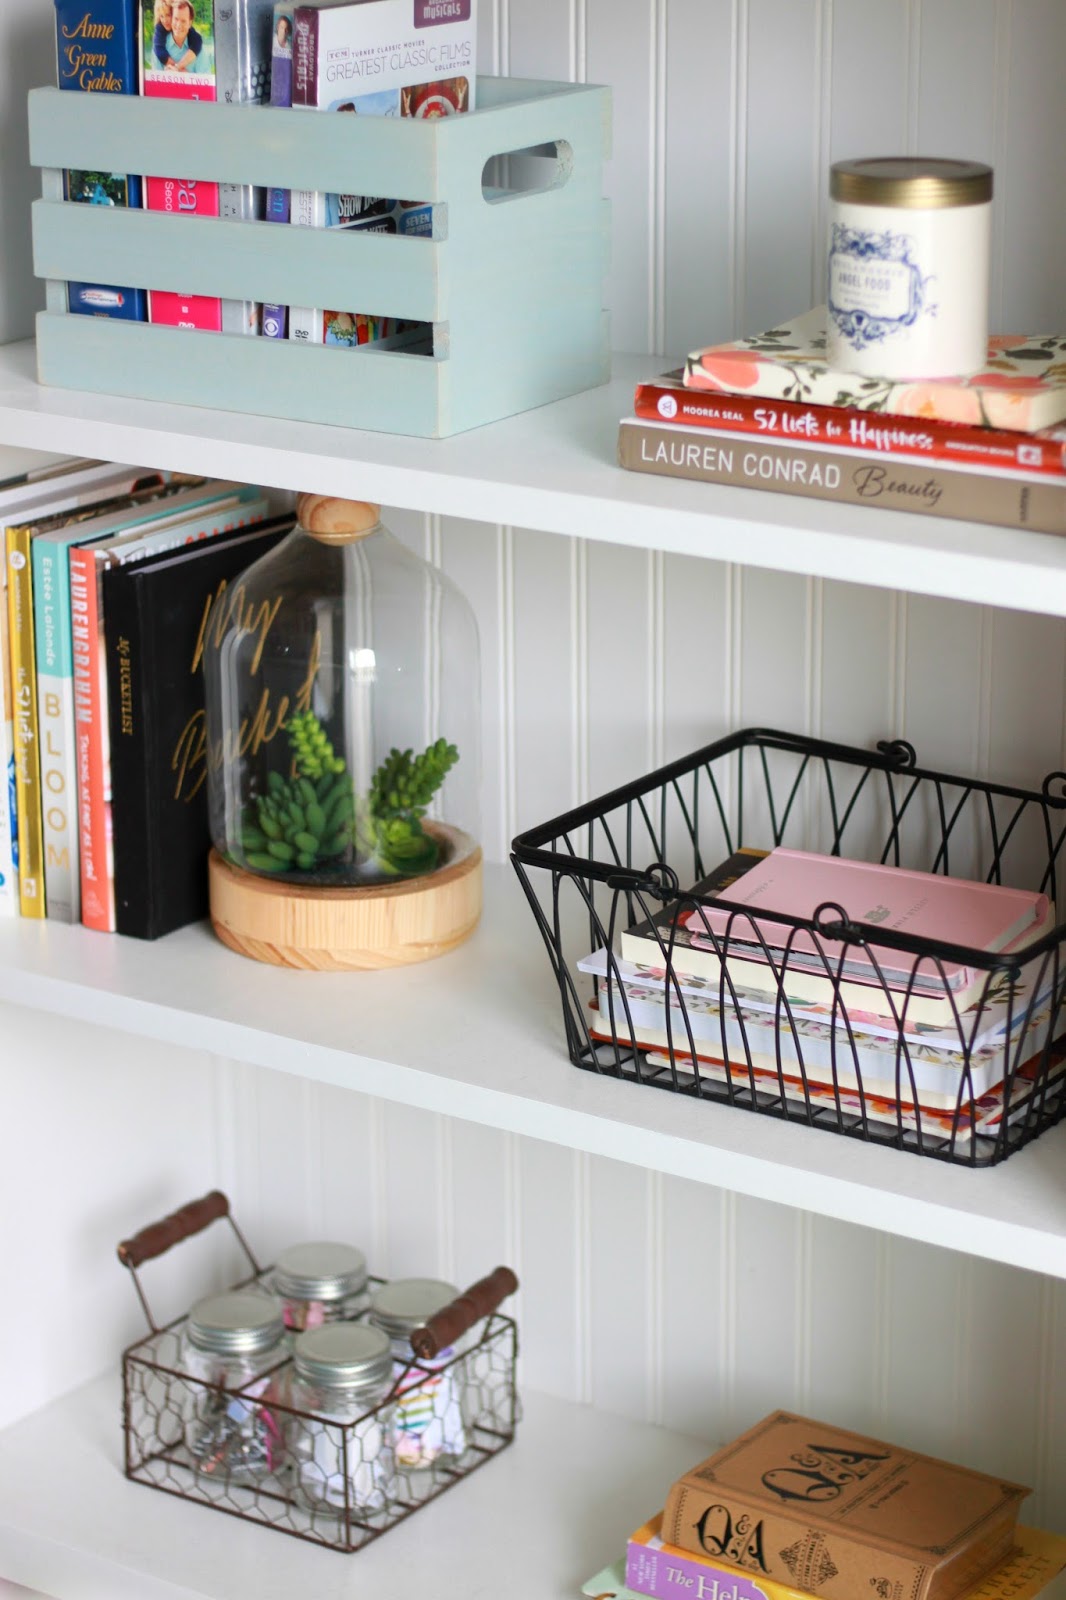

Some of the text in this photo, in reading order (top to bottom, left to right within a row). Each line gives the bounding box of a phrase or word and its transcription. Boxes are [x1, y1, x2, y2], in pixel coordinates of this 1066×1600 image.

[62, 13, 115, 40] Anne
[423, 3, 462, 19] MUSICALS
[62, 44, 107, 78] Green
[296, 21, 310, 91] MUSICALS
[308, 33, 316, 83] BROADWAY
[326, 41, 472, 82] GREATEST CLASSIC FILMS
[329, 39, 426, 59] TCM TURNER CLASSIC MOVIES
[434, 60, 471, 72] COLLECTION
[79, 69, 123, 92] Gables
[150, 74, 210, 86] SEASON TWO
[164, 181, 175, 211] Seco
[338, 194, 361, 217] SHOW
[864, 276, 892, 291] FOOD
[682, 405, 720, 419] MOOREA
[722, 410, 745, 422] SEAL
[753, 408, 778, 431] 52
[849, 418, 934, 451] Happiness
[641, 438, 944, 507] LAUREN CONRAD Beauty
[191, 579, 283, 677] My
[117, 637, 131, 657] My
[42, 556, 69, 870] Estée Lalande BLOOM
[761, 1443, 892, 1502] Q&A
[692, 1503, 773, 1575] Q&A
[666, 1566, 753, 1600] The Hel
